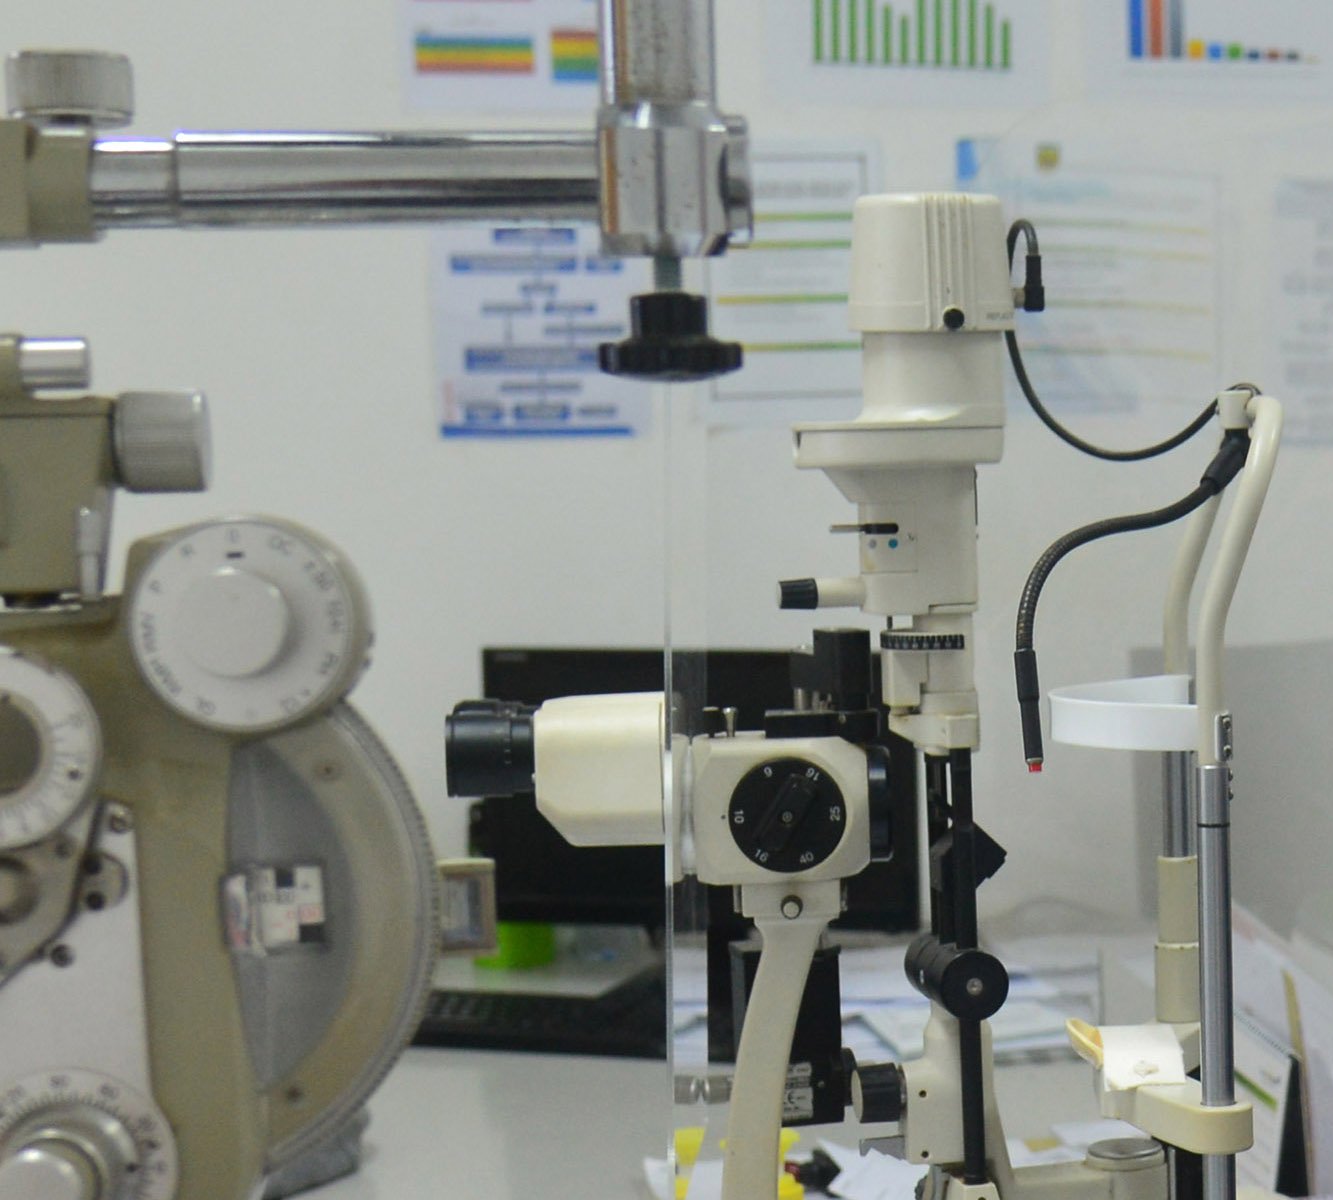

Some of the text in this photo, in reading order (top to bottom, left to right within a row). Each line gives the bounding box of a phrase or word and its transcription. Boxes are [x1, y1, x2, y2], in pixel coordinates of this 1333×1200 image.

[805, 767, 820, 781] 16
[734, 809, 745, 824] 10
[829, 805, 841, 822] 25
[755, 848, 769, 862] 16
